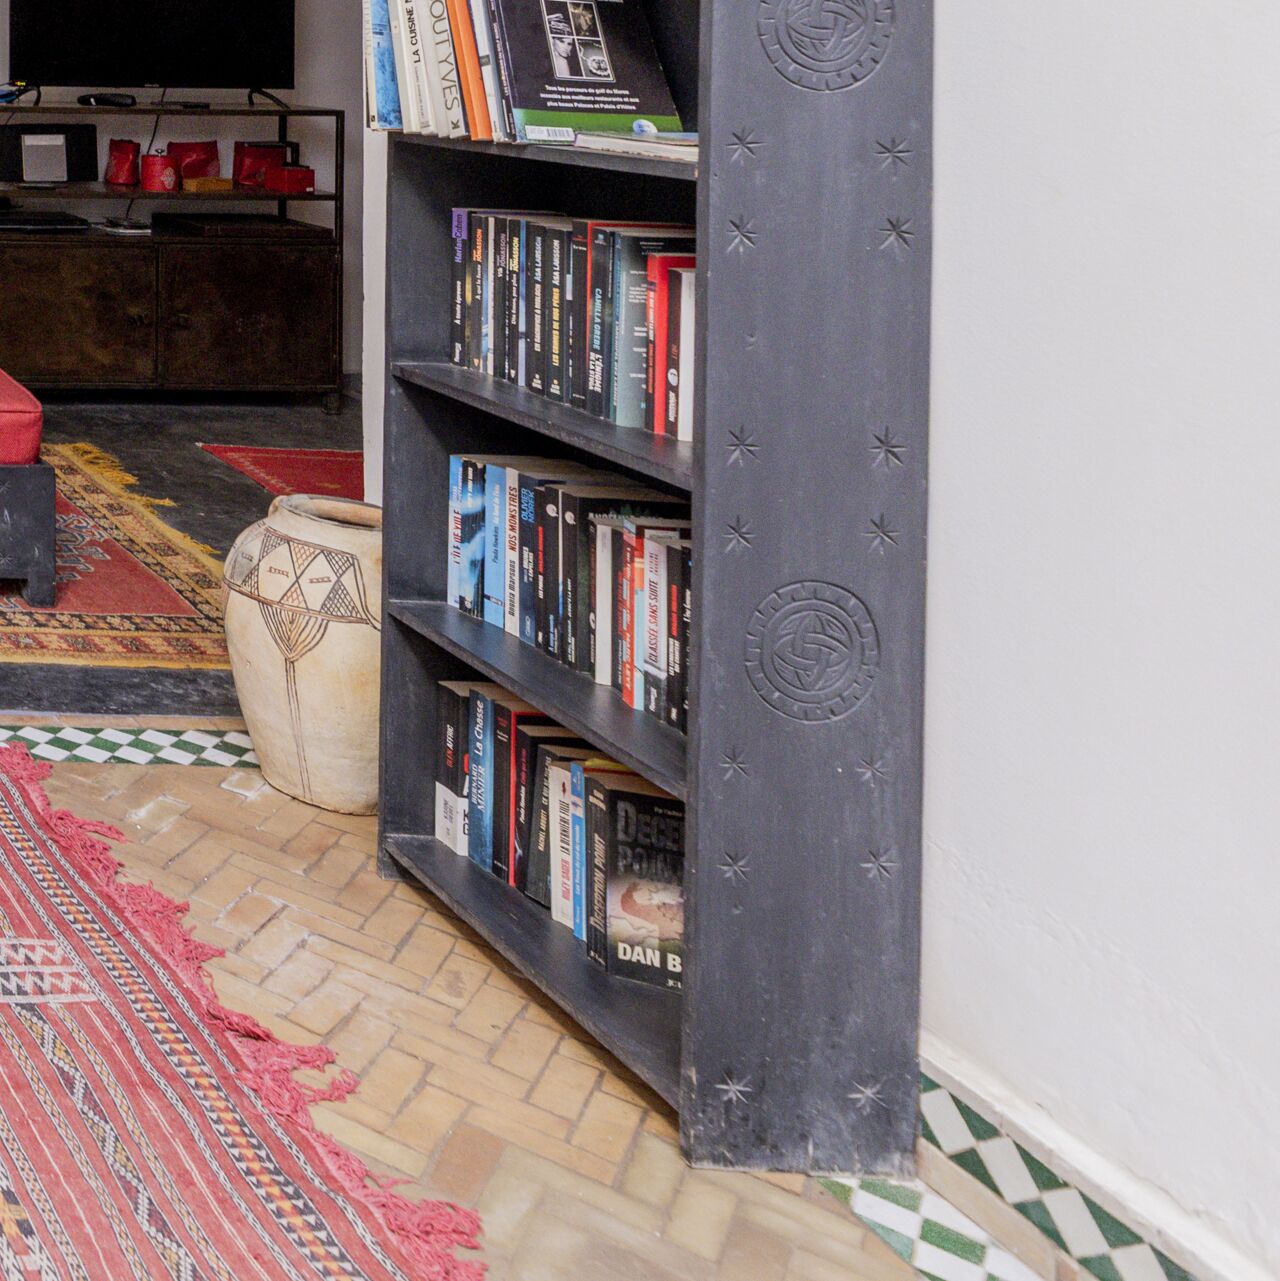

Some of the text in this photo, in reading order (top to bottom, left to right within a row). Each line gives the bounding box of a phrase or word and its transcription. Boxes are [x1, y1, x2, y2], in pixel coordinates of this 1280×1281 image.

[405, 6, 418, 46] CUISINE
[413, 48, 421, 63] LA
[438, 50, 460, 111] YVES
[454, 238, 462, 263] Harlan
[534, 236, 542, 267] LARSSON
[552, 239, 560, 271] LARSSON
[593, 288, 602, 350] CAMILLA GREBE
[594, 354, 603, 393] L'ÉNIGME
[508, 486, 518, 552] NOS MONSTRES
[527, 491, 535, 523] NOREK
[648, 579, 658, 603] SUITE
[648, 604, 658, 627] SANS
[647, 627, 658, 663] CLASSÉE
[474, 700, 484, 756] La Chasse
[477, 765, 486, 812] MINIER
[559, 800, 570, 815] FILLE
[559, 845, 570, 856] LA
[590, 833, 607, 934] DECEPTION POINT
[617, 941, 661, 968] DAN
